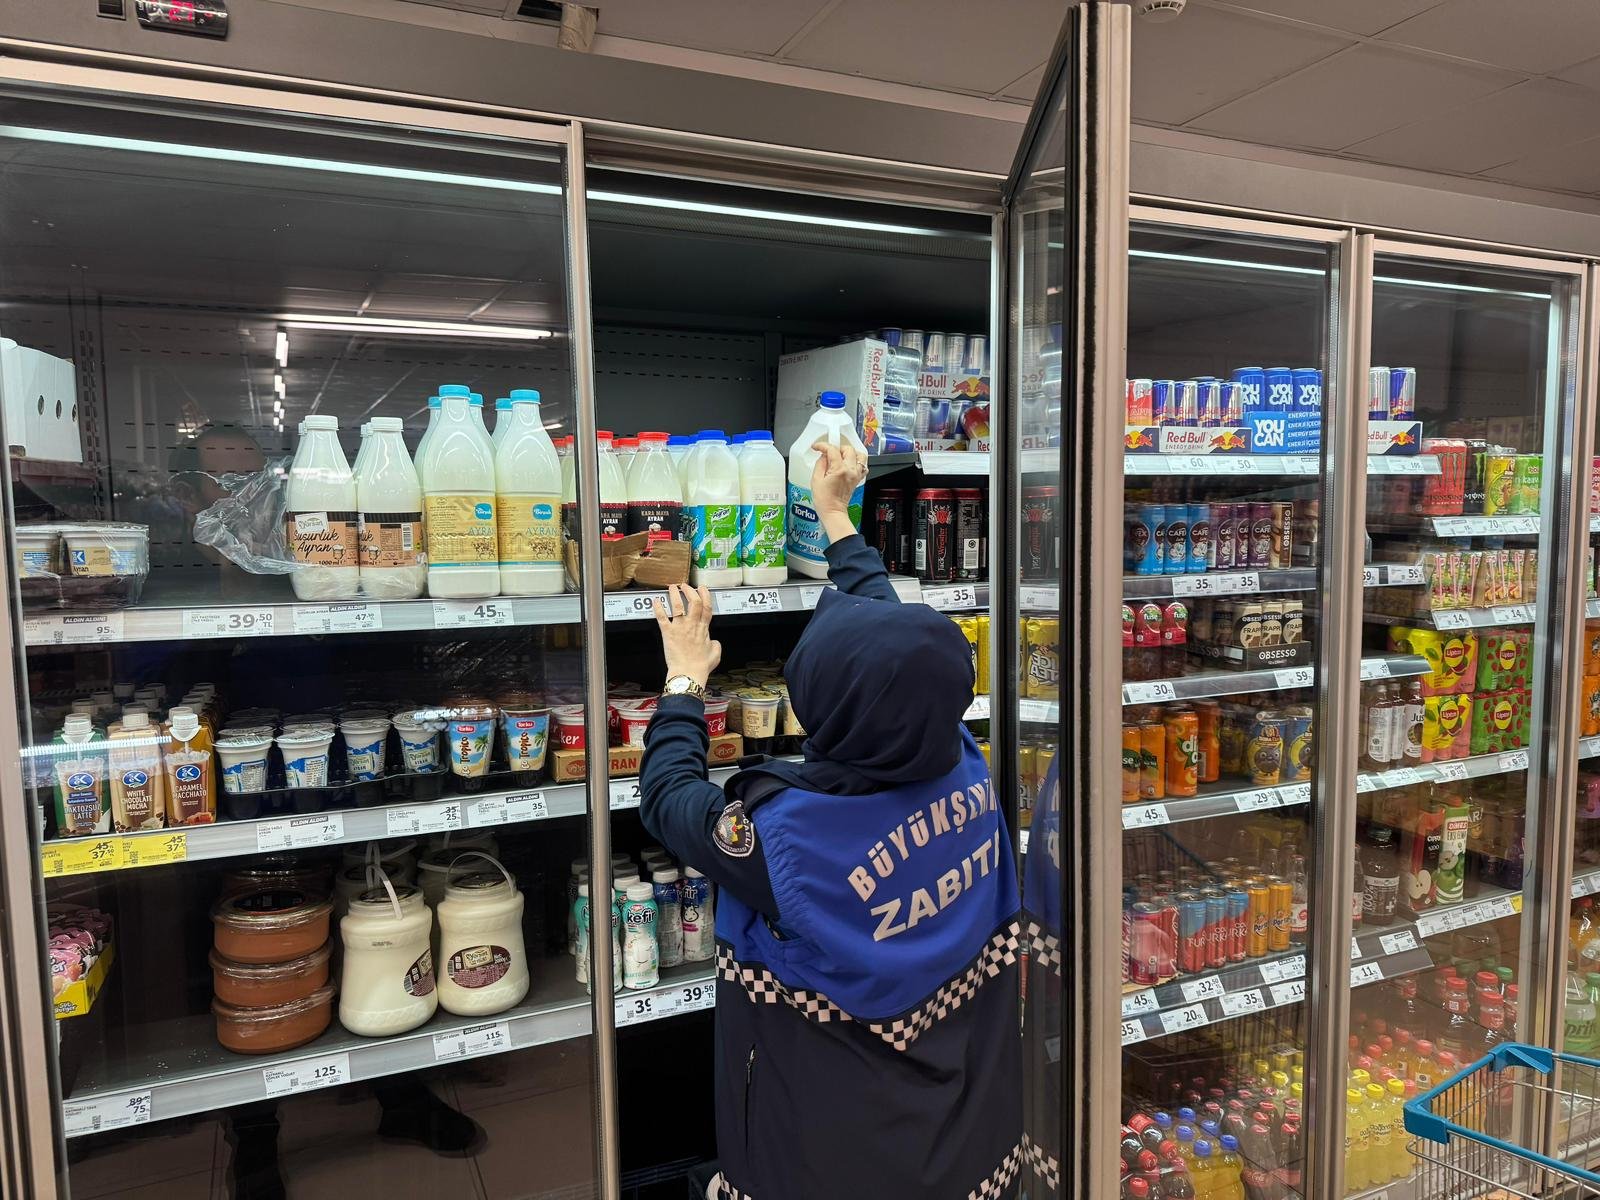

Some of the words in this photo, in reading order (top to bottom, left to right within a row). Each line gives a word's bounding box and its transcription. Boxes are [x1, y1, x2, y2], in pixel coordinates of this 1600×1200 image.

[871, 348, 884, 374] Red
[870, 372, 881, 397] Bull
[926, 374, 947, 388] Bull
[1242, 384, 1260, 394] OU
[1242, 394, 1260, 405] AN
[1269, 394, 1293, 405] CA
[1254, 419, 1286, 434] YOU
[1166, 432, 1186, 442] Red
[1187, 432, 1206, 443] Bull
[1254, 432, 1284, 447] CAN
[1368, 432, 1376, 440] ed
[1376, 431, 1388, 440] Bull
[978, 440, 990, 452] Re
[1190, 458, 1204, 468] 60
[1238, 460, 1250, 470] 50
[1464, 492, 1486, 500] MONS
[794, 505, 816, 520] Torku
[1488, 520, 1498, 529] 70
[294, 528, 340, 542] Susurluk
[468, 527, 495, 536] AYRA
[526, 527, 559, 536] AYRAN
[296, 542, 333, 559] Ayran
[1195, 578, 1208, 590] 35
[1240, 576, 1254, 587] 35
[953, 589, 969, 601] 35
[474, 604, 497, 618] 45
[1174, 611, 1187, 620] fuse
[1511, 608, 1522, 618] 14
[1144, 612, 1158, 622] fuse
[1452, 614, 1464, 624] 14
[96, 626, 110, 634] 95
[1258, 648, 1296, 660] OBSESSO
[1296, 670, 1308, 682] 59
[1153, 684, 1168, 696] 30
[560, 732, 579, 746] ker
[611, 758, 636, 770] RAN
[175, 784, 204, 792] CARAMEL
[1298, 786, 1311, 800] 59
[121, 794, 152, 805] CHOCOLATE
[126, 790, 145, 798] WHITE
[126, 802, 148, 810] MOCHA
[532, 802, 542, 810] 35
[73, 812, 92, 820] LATTE
[1144, 808, 1158, 820] 45
[870, 828, 1000, 942] ZABIT
[627, 908, 656, 924] kefir
[1290, 985, 1303, 996] 11
[1134, 994, 1148, 1006] 45
[1244, 993, 1258, 1005] 35
[1184, 1010, 1196, 1022] 20
[1566, 1020, 1594, 1038] prit
[486, 1030, 500, 1041] 115
[314, 1065, 336, 1078] 125
[133, 1105, 146, 1114] 75
